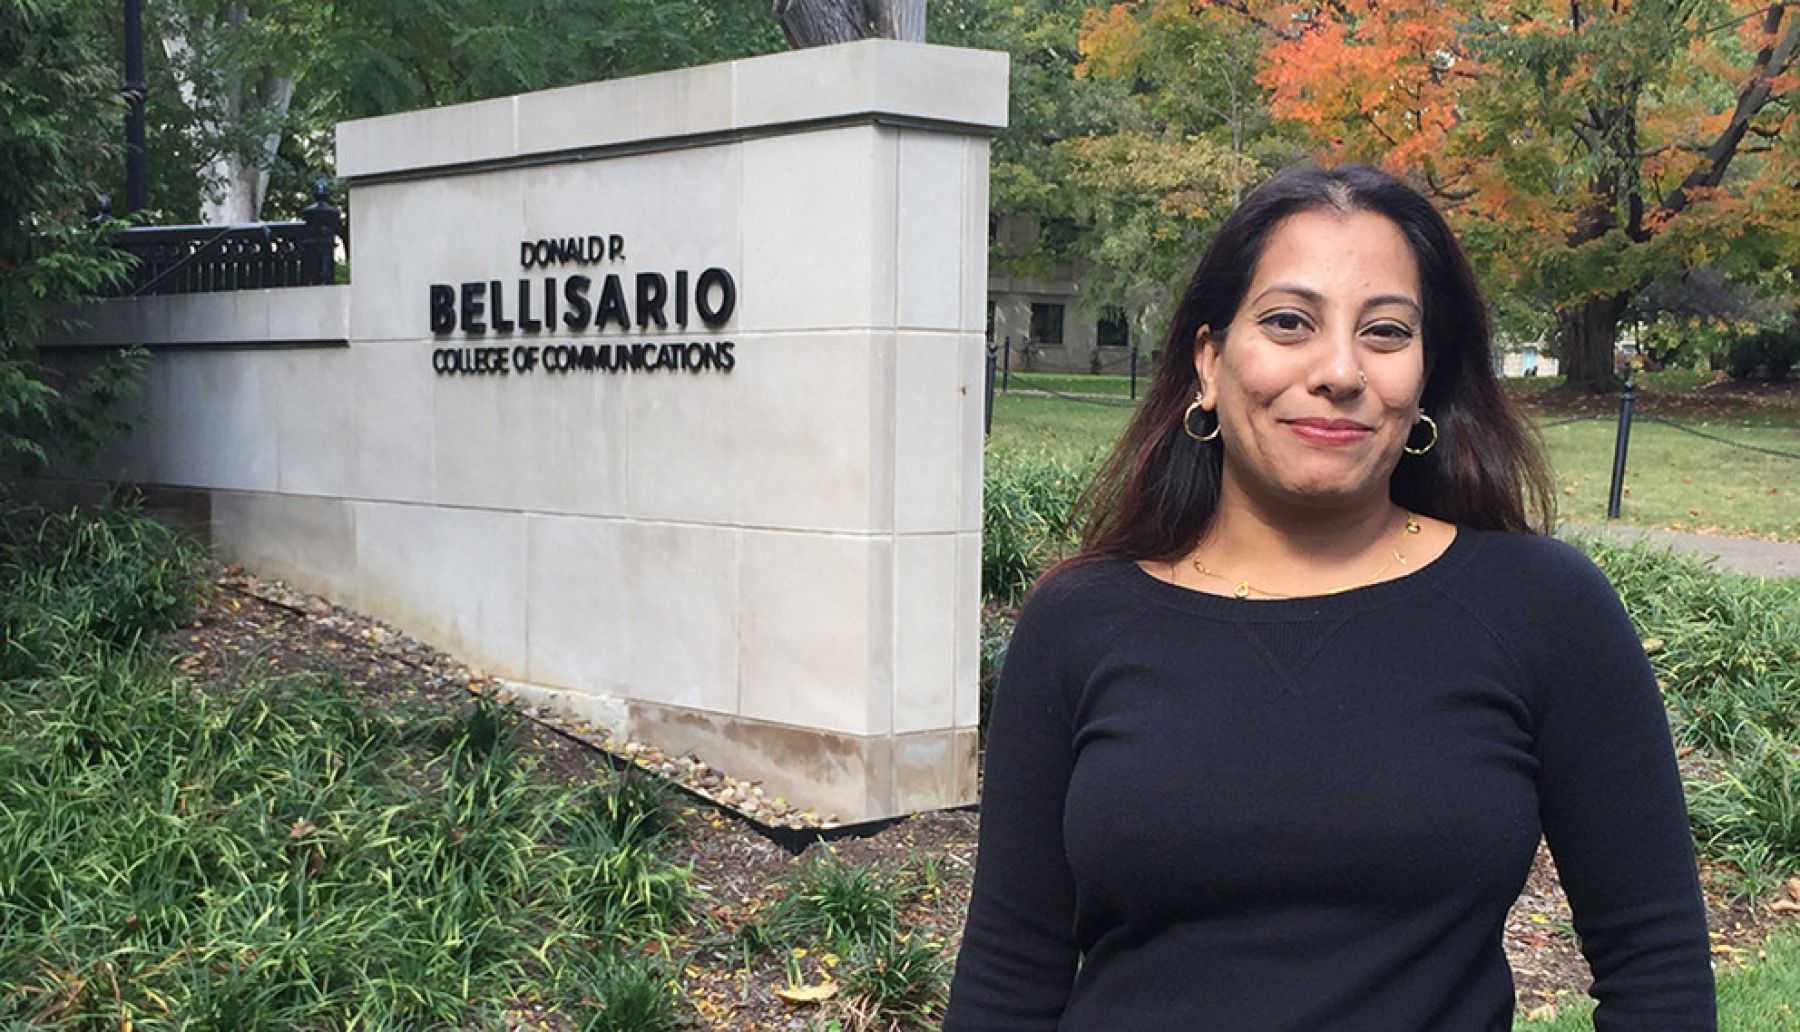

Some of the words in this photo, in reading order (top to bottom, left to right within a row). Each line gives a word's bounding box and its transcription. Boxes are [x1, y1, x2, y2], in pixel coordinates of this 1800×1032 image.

[521, 235, 604, 267] DONALD
[609, 234, 626, 262] P.
[430, 267, 736, 333] BELLISARIO
[433, 346, 510, 375] COLLEGE
[513, 345, 539, 372] OF
[542, 342, 735, 373] COMMUNICATIONS
